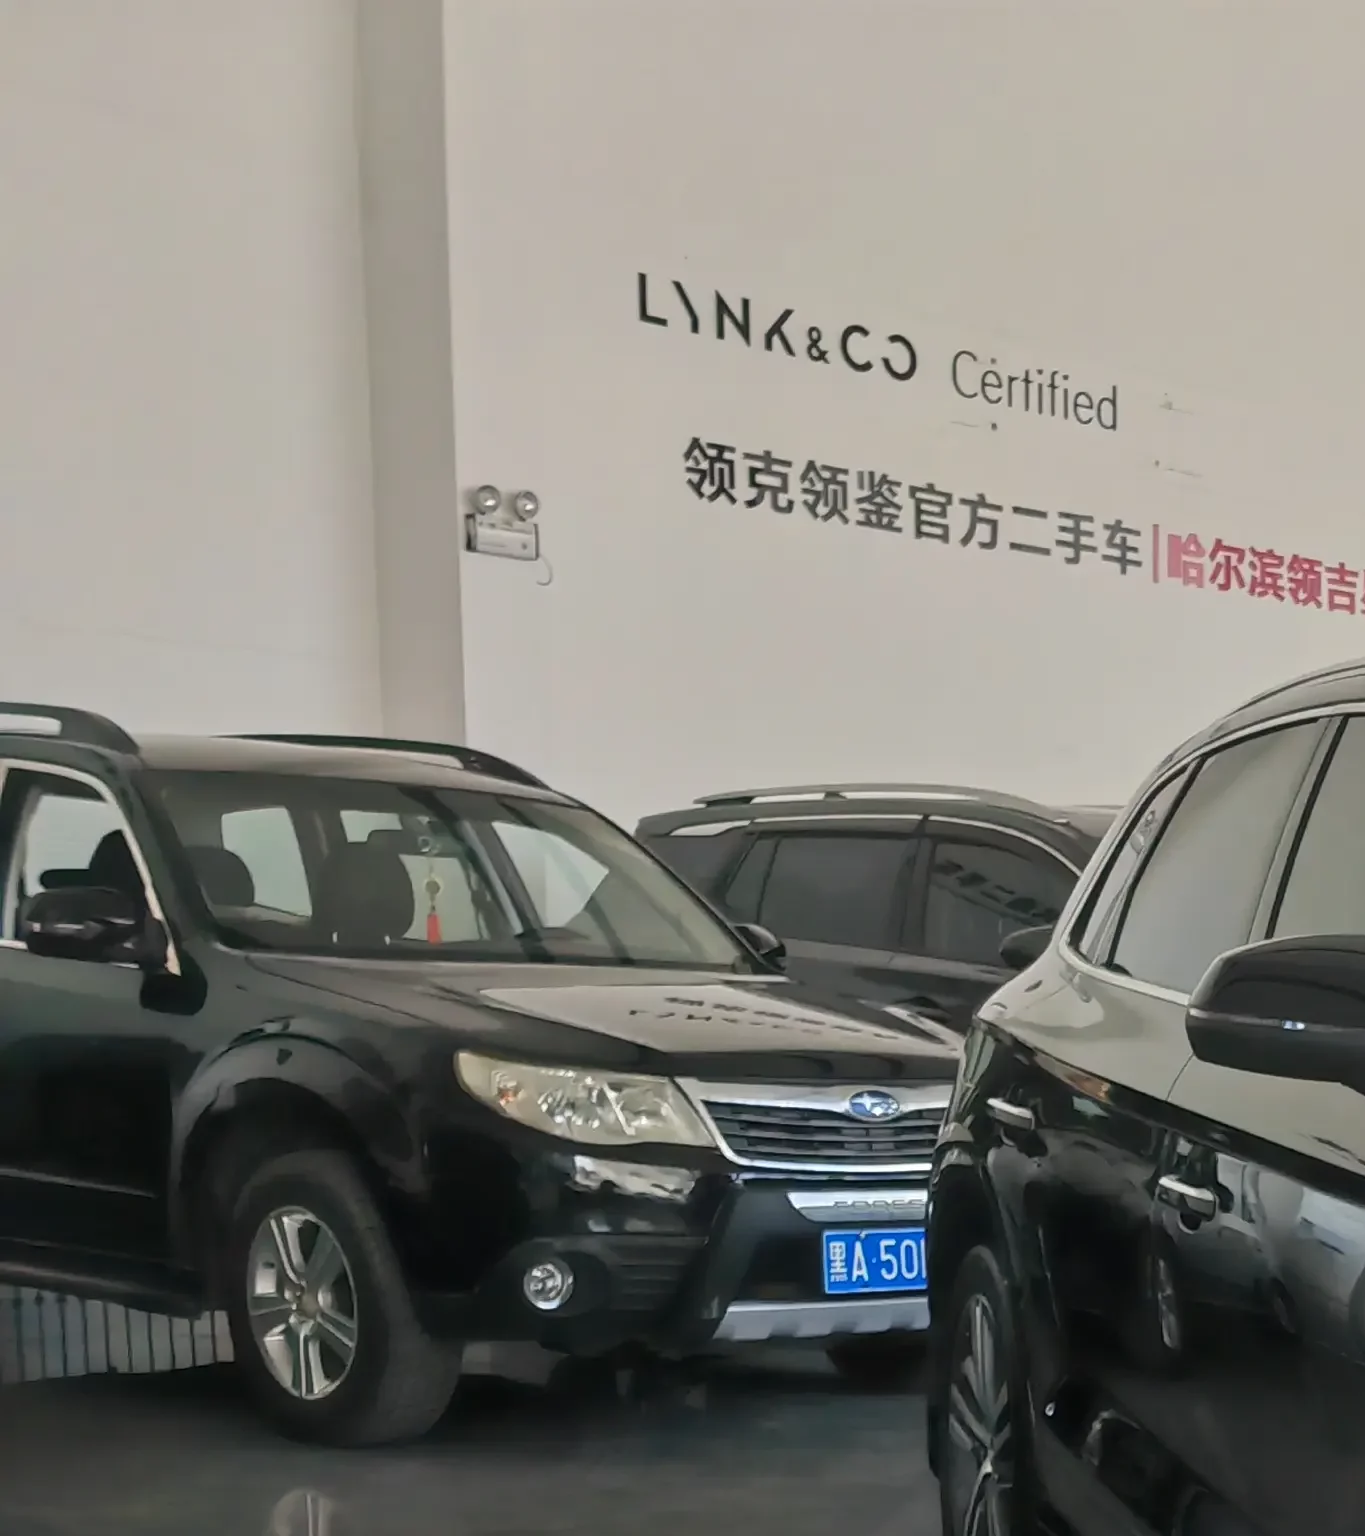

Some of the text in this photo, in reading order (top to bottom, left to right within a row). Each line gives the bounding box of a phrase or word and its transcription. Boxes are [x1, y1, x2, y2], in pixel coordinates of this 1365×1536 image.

[951, 350, 1118, 430] Certified
[682, 437, 1143, 576] 领克领鉴官方二手车
